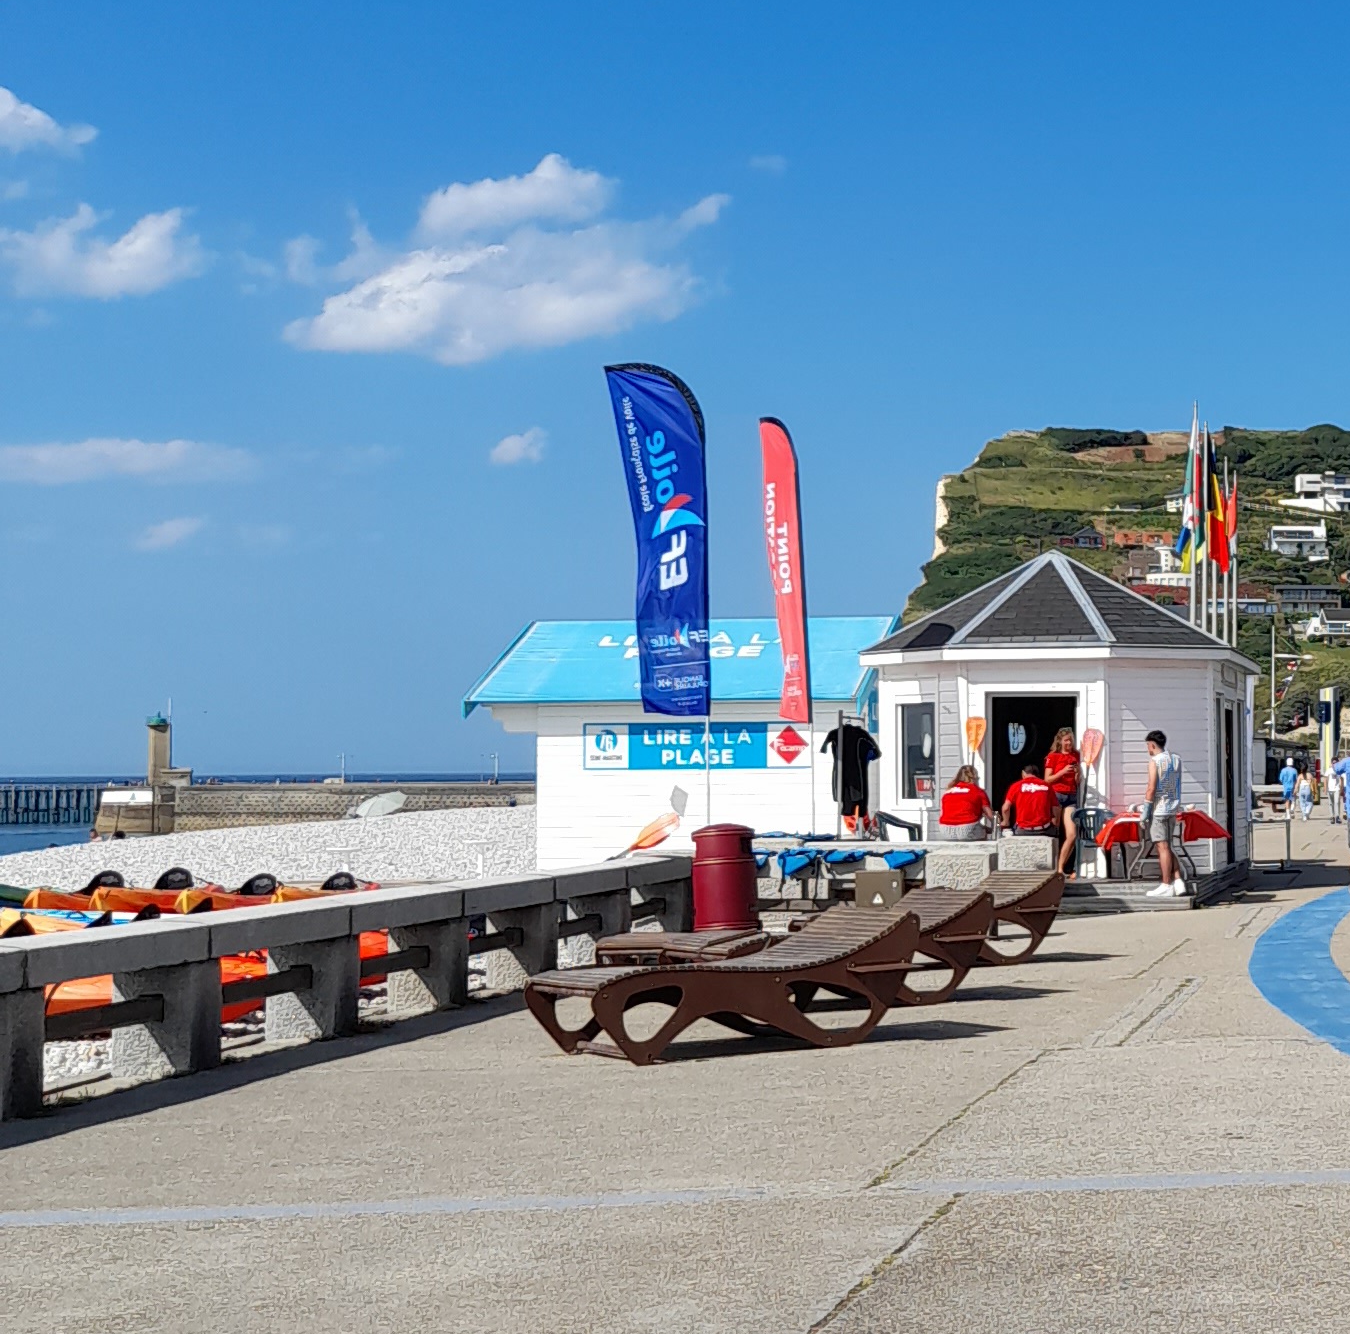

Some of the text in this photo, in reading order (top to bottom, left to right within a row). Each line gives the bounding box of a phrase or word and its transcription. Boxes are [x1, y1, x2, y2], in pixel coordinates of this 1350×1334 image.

[623, 646, 765, 658] PGE
[643, 729, 693, 745] LIRE
[723, 728, 752, 745] LA
[661, 748, 735, 765] PLAGE
